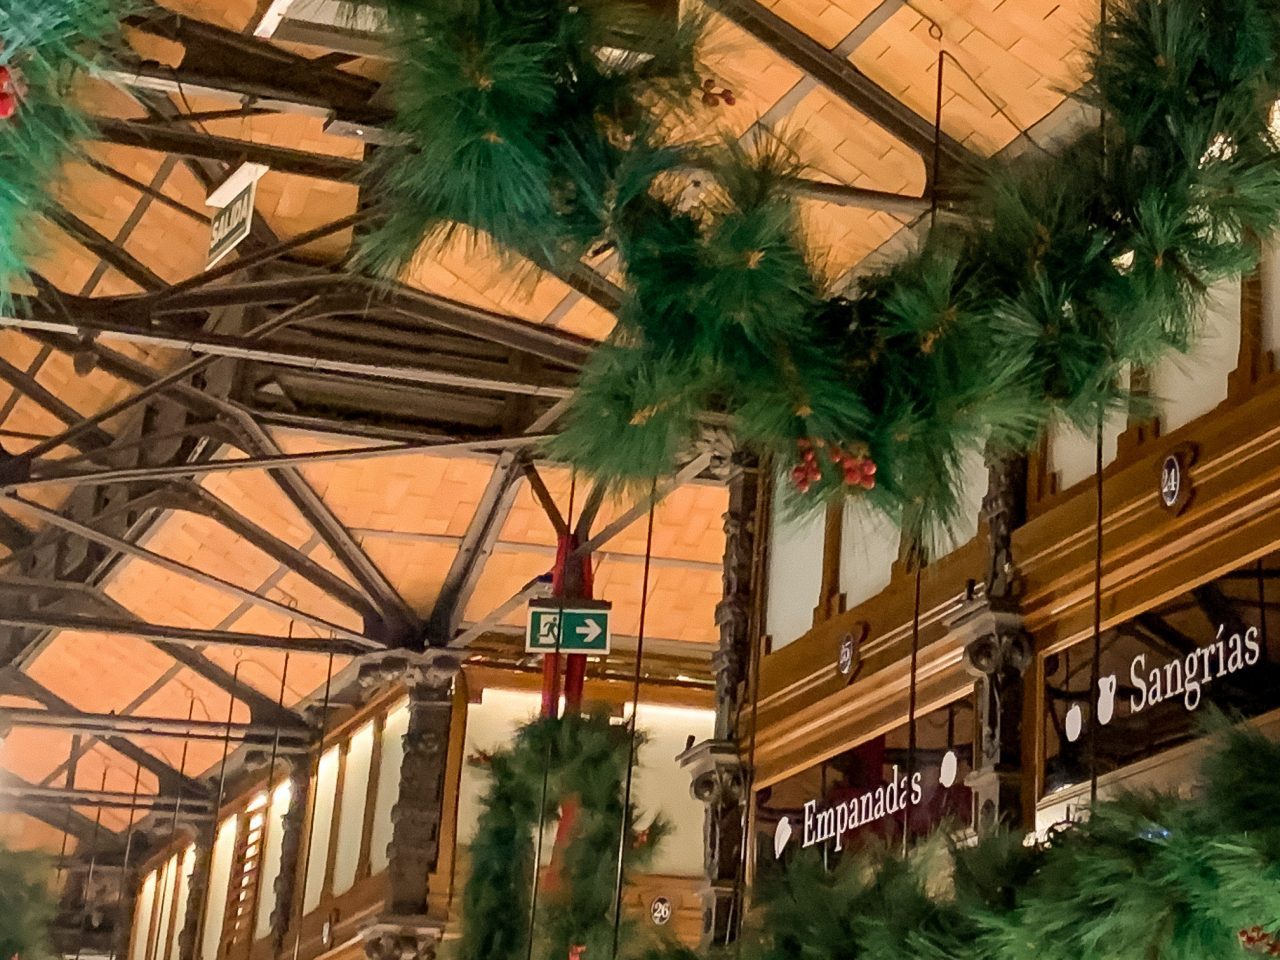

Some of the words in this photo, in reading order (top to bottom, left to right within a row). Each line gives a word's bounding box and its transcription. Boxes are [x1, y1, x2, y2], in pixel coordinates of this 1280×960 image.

[1162, 468, 1177, 492] 24
[1130, 623, 1260, 713] Sangrías
[802, 764, 922, 852] Empanadas
[653, 901, 669, 918] 26
